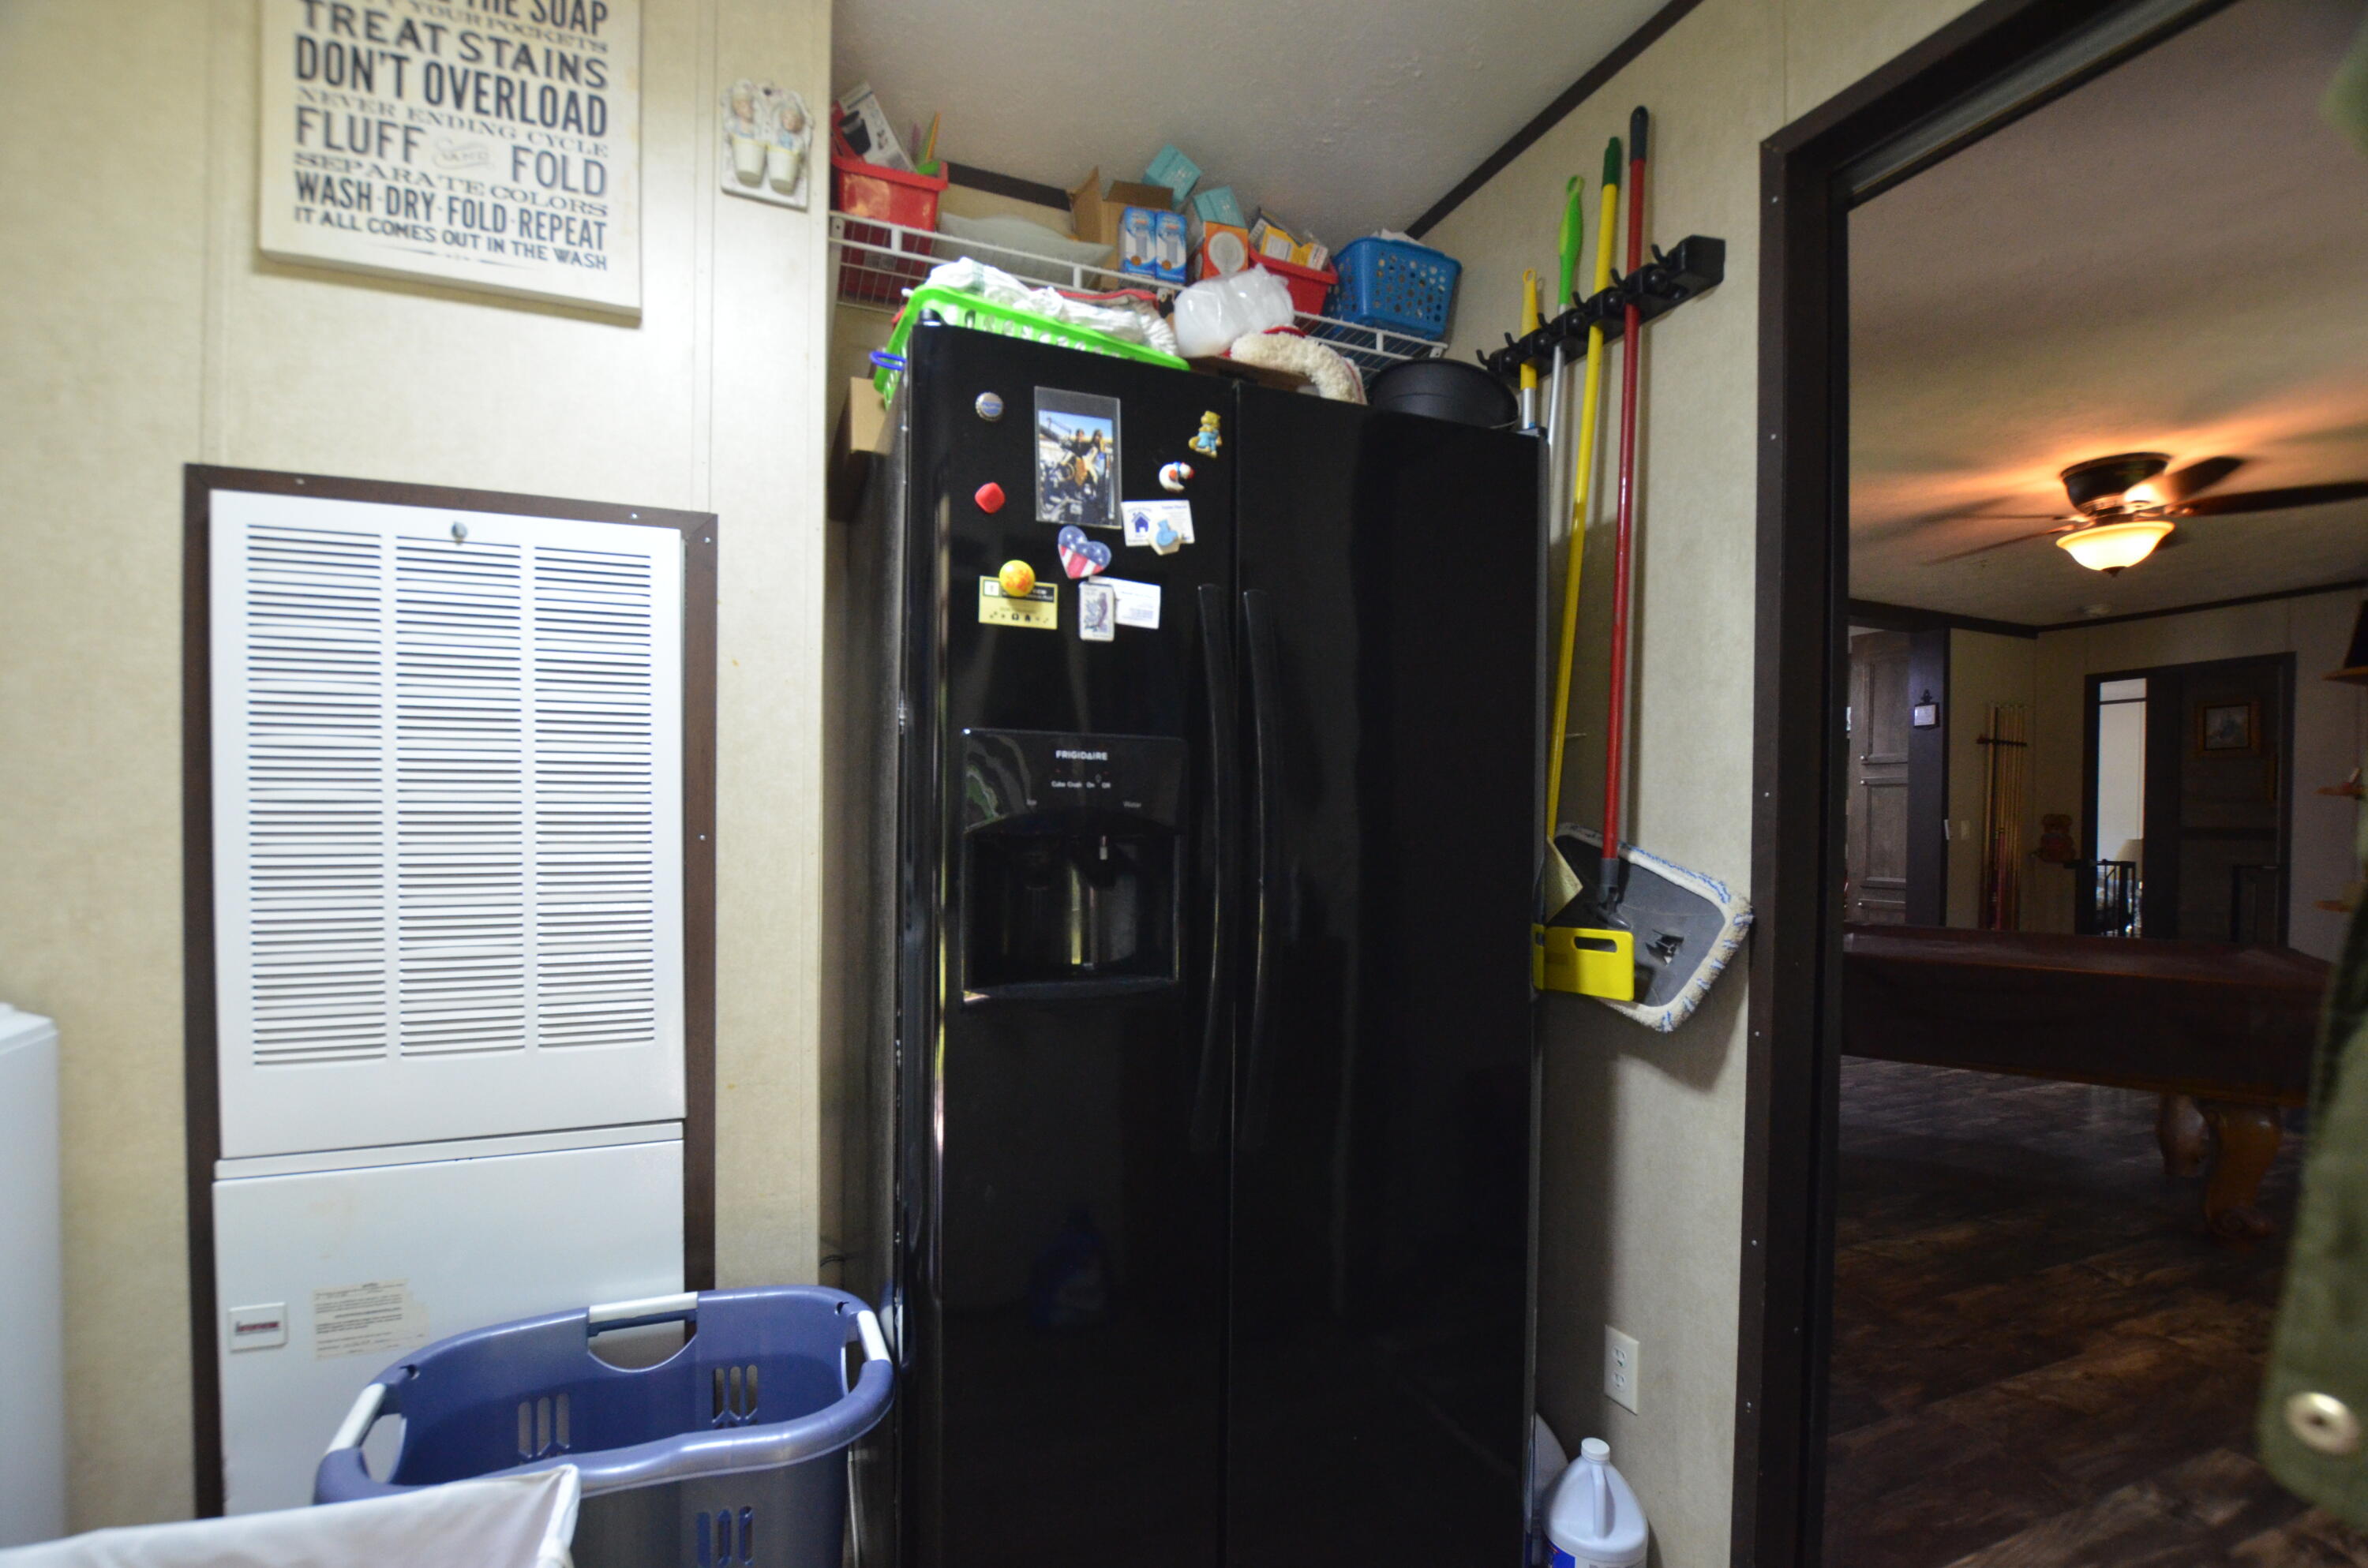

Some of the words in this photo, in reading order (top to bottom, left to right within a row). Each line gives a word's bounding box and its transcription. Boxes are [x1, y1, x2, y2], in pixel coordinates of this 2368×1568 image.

[301, 0, 449, 55] TREAT
[458, 30, 608, 89] STAINS
[529, 0, 608, 36] SOAP
[295, 32, 410, 99] DON'T
[424, 60, 607, 137] OVERLOAD
[296, 104, 427, 163] FLUFF
[512, 144, 607, 197] FOLD
[297, 85, 396, 116] NEVER
[407, 106, 517, 140] ENDING
[527, 130, 609, 158] CYCLE
[294, 152, 485, 196] SEPARATE
[490, 185, 608, 217] COLORS
[295, 170, 372, 213] WASH
[386, 185, 436, 222] DRY
[448, 195, 507, 234] FOLD
[519, 208, 607, 251] REPEAT
[295, 205, 316, 224] IT
[320, 211, 363, 233] ALL
[366, 217, 437, 243] COMES
[442, 229, 481, 250] OUT
[486, 236, 506, 254] IN
[511, 240, 549, 261] THE
[553, 247, 608, 271] WASH
[1055, 750, 1108, 762] FRIGIDAIRE
